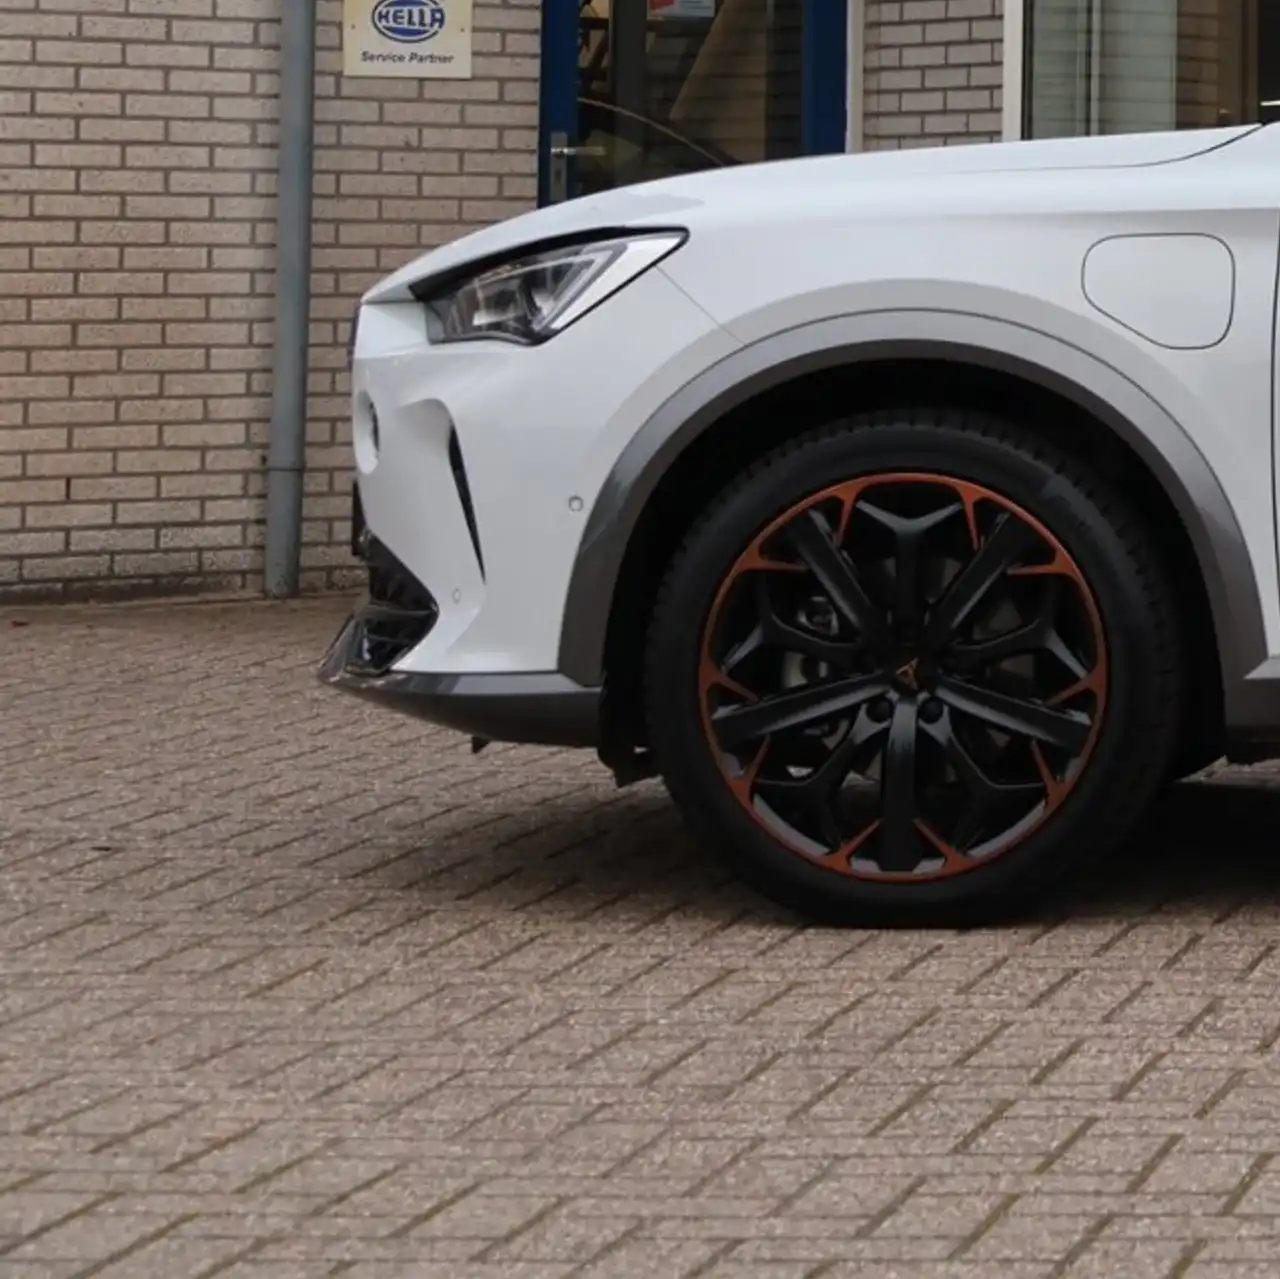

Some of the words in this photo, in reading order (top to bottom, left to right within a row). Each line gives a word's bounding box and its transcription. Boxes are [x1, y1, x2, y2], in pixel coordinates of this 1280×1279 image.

[378, 7, 446, 29] HELLA
[361, 50, 406, 62] Service
[408, 51, 454, 63] Partner
